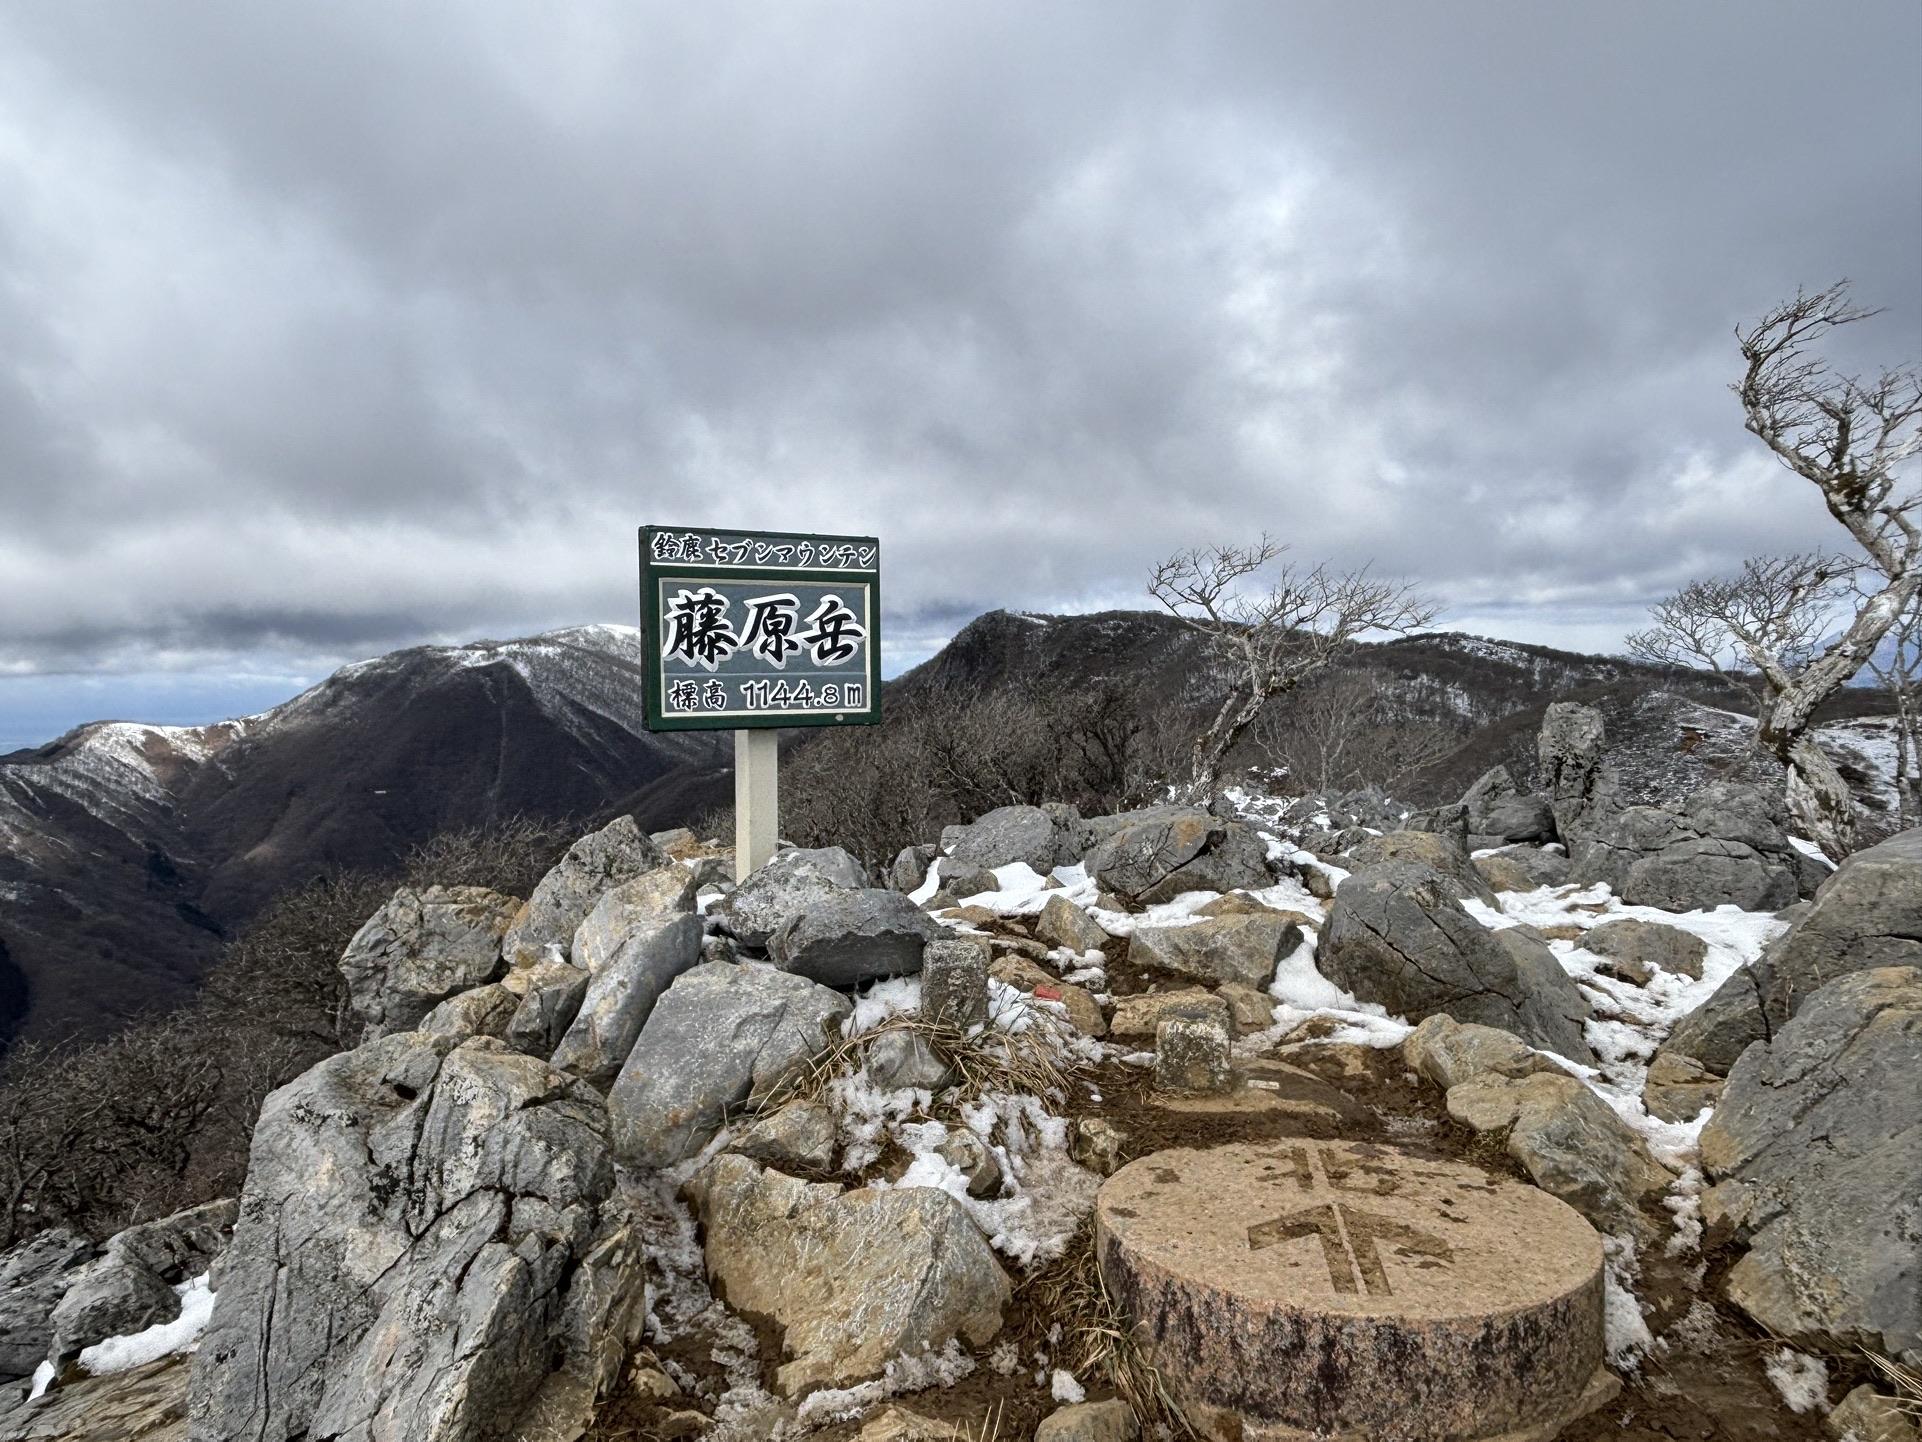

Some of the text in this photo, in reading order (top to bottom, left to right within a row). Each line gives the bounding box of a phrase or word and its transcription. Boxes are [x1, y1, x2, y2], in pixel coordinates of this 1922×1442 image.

[663, 588, 866, 671] 藤原岳
[669, 679, 727, 711] 標高
